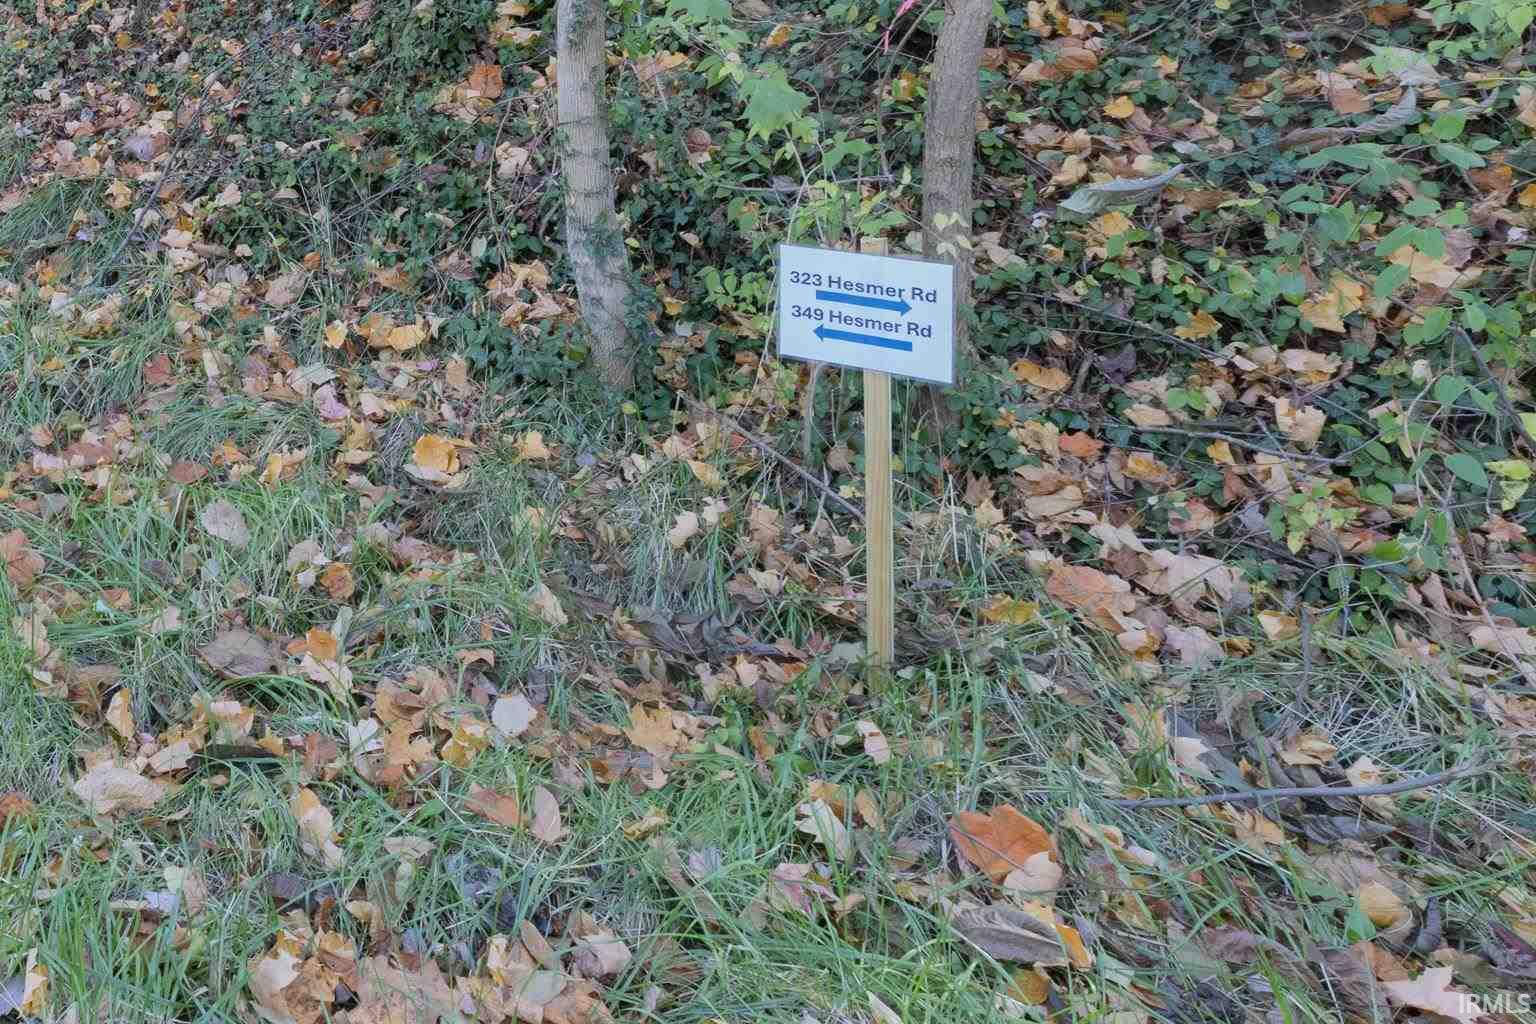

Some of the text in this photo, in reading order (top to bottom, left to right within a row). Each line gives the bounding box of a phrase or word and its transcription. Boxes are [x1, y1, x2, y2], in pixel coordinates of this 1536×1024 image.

[790, 270, 937, 303] 323 Hesmer Rd
[791, 305, 932, 338] 349 Hesmer Rd
